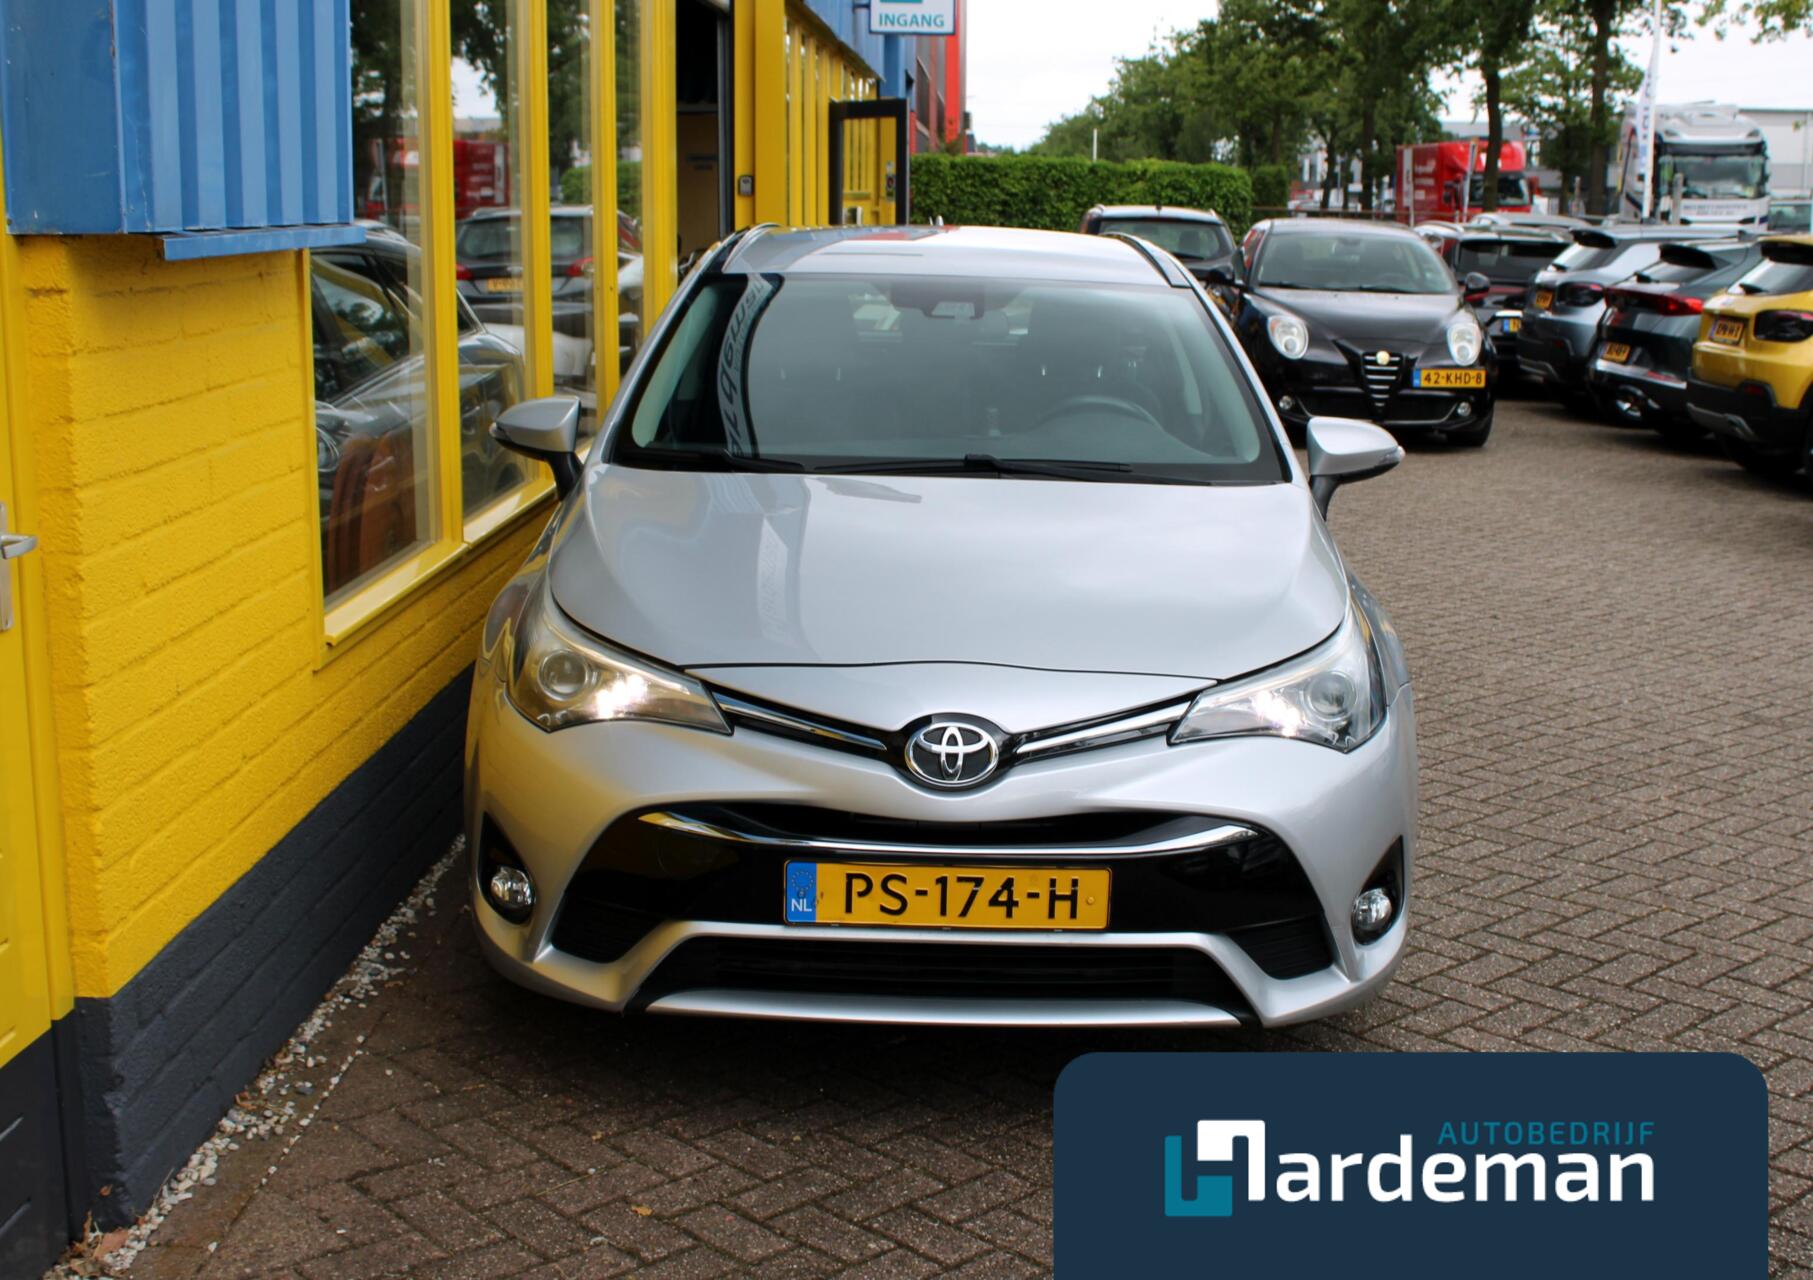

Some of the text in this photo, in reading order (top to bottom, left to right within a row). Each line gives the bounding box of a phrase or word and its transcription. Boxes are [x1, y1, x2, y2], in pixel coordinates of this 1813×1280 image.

[879, 13, 945, 27] INGANG
[1423, 371, 1483, 386] 42-KHD-8
[844, 872, 1079, 920] PS-174-H
[791, 898, 813, 913] NL
